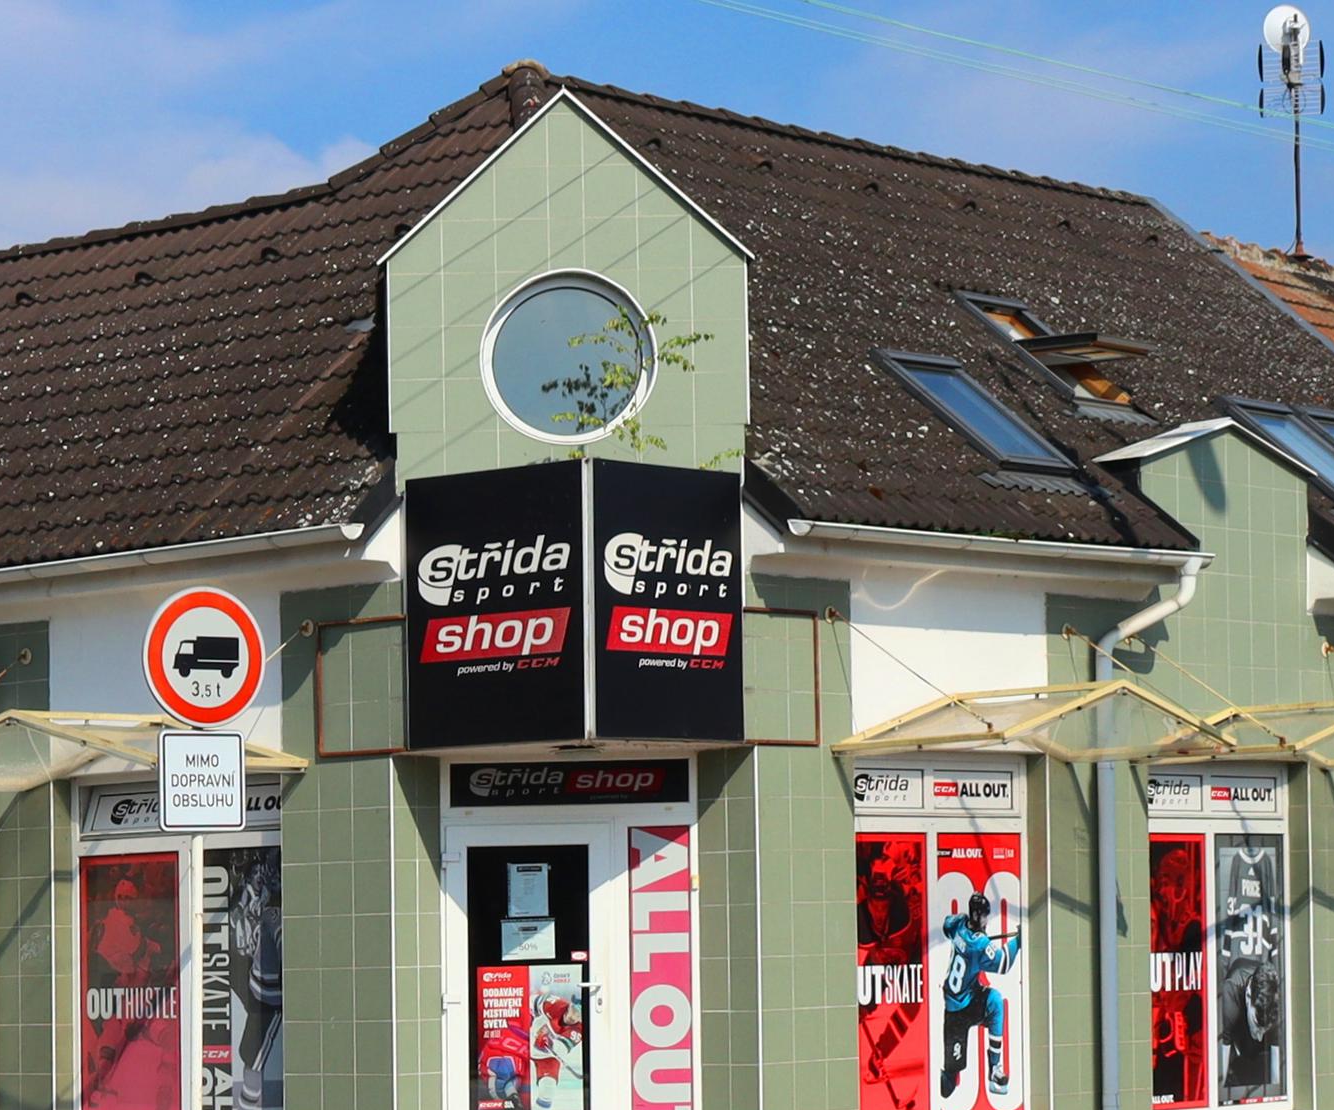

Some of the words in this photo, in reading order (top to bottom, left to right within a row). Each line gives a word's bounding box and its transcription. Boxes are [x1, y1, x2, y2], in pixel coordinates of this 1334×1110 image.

[453, 576, 564, 605] sport
[635, 580, 728, 598] sport
[436, 615, 554, 656] shop
[619, 609, 720, 655] shop
[457, 661, 501, 677] powered
[503, 661, 515, 673] by
[518, 657, 560, 669] CCM
[638, 658, 676, 669] powered
[678, 659, 688, 670] by
[689, 659, 725, 669] CCM
[192, 681, 212, 699] 3,5
[217, 682, 221, 698] t
[185, 754, 219, 768] MIMO
[171, 772, 235, 787] DOPRAVNÍ
[576, 770, 655, 791] shop
[491, 787, 561, 798] sport
[960, 783, 981, 798] ALL
[1233, 787, 1251, 801] ALL
[172, 794, 234, 807] OBSLUHU
[246, 797, 262, 811] LL
[952, 848, 966, 858] ALL
[632, 828, 689, 972] ALL
[87, 986, 178, 1020] OUTHUSTLE
